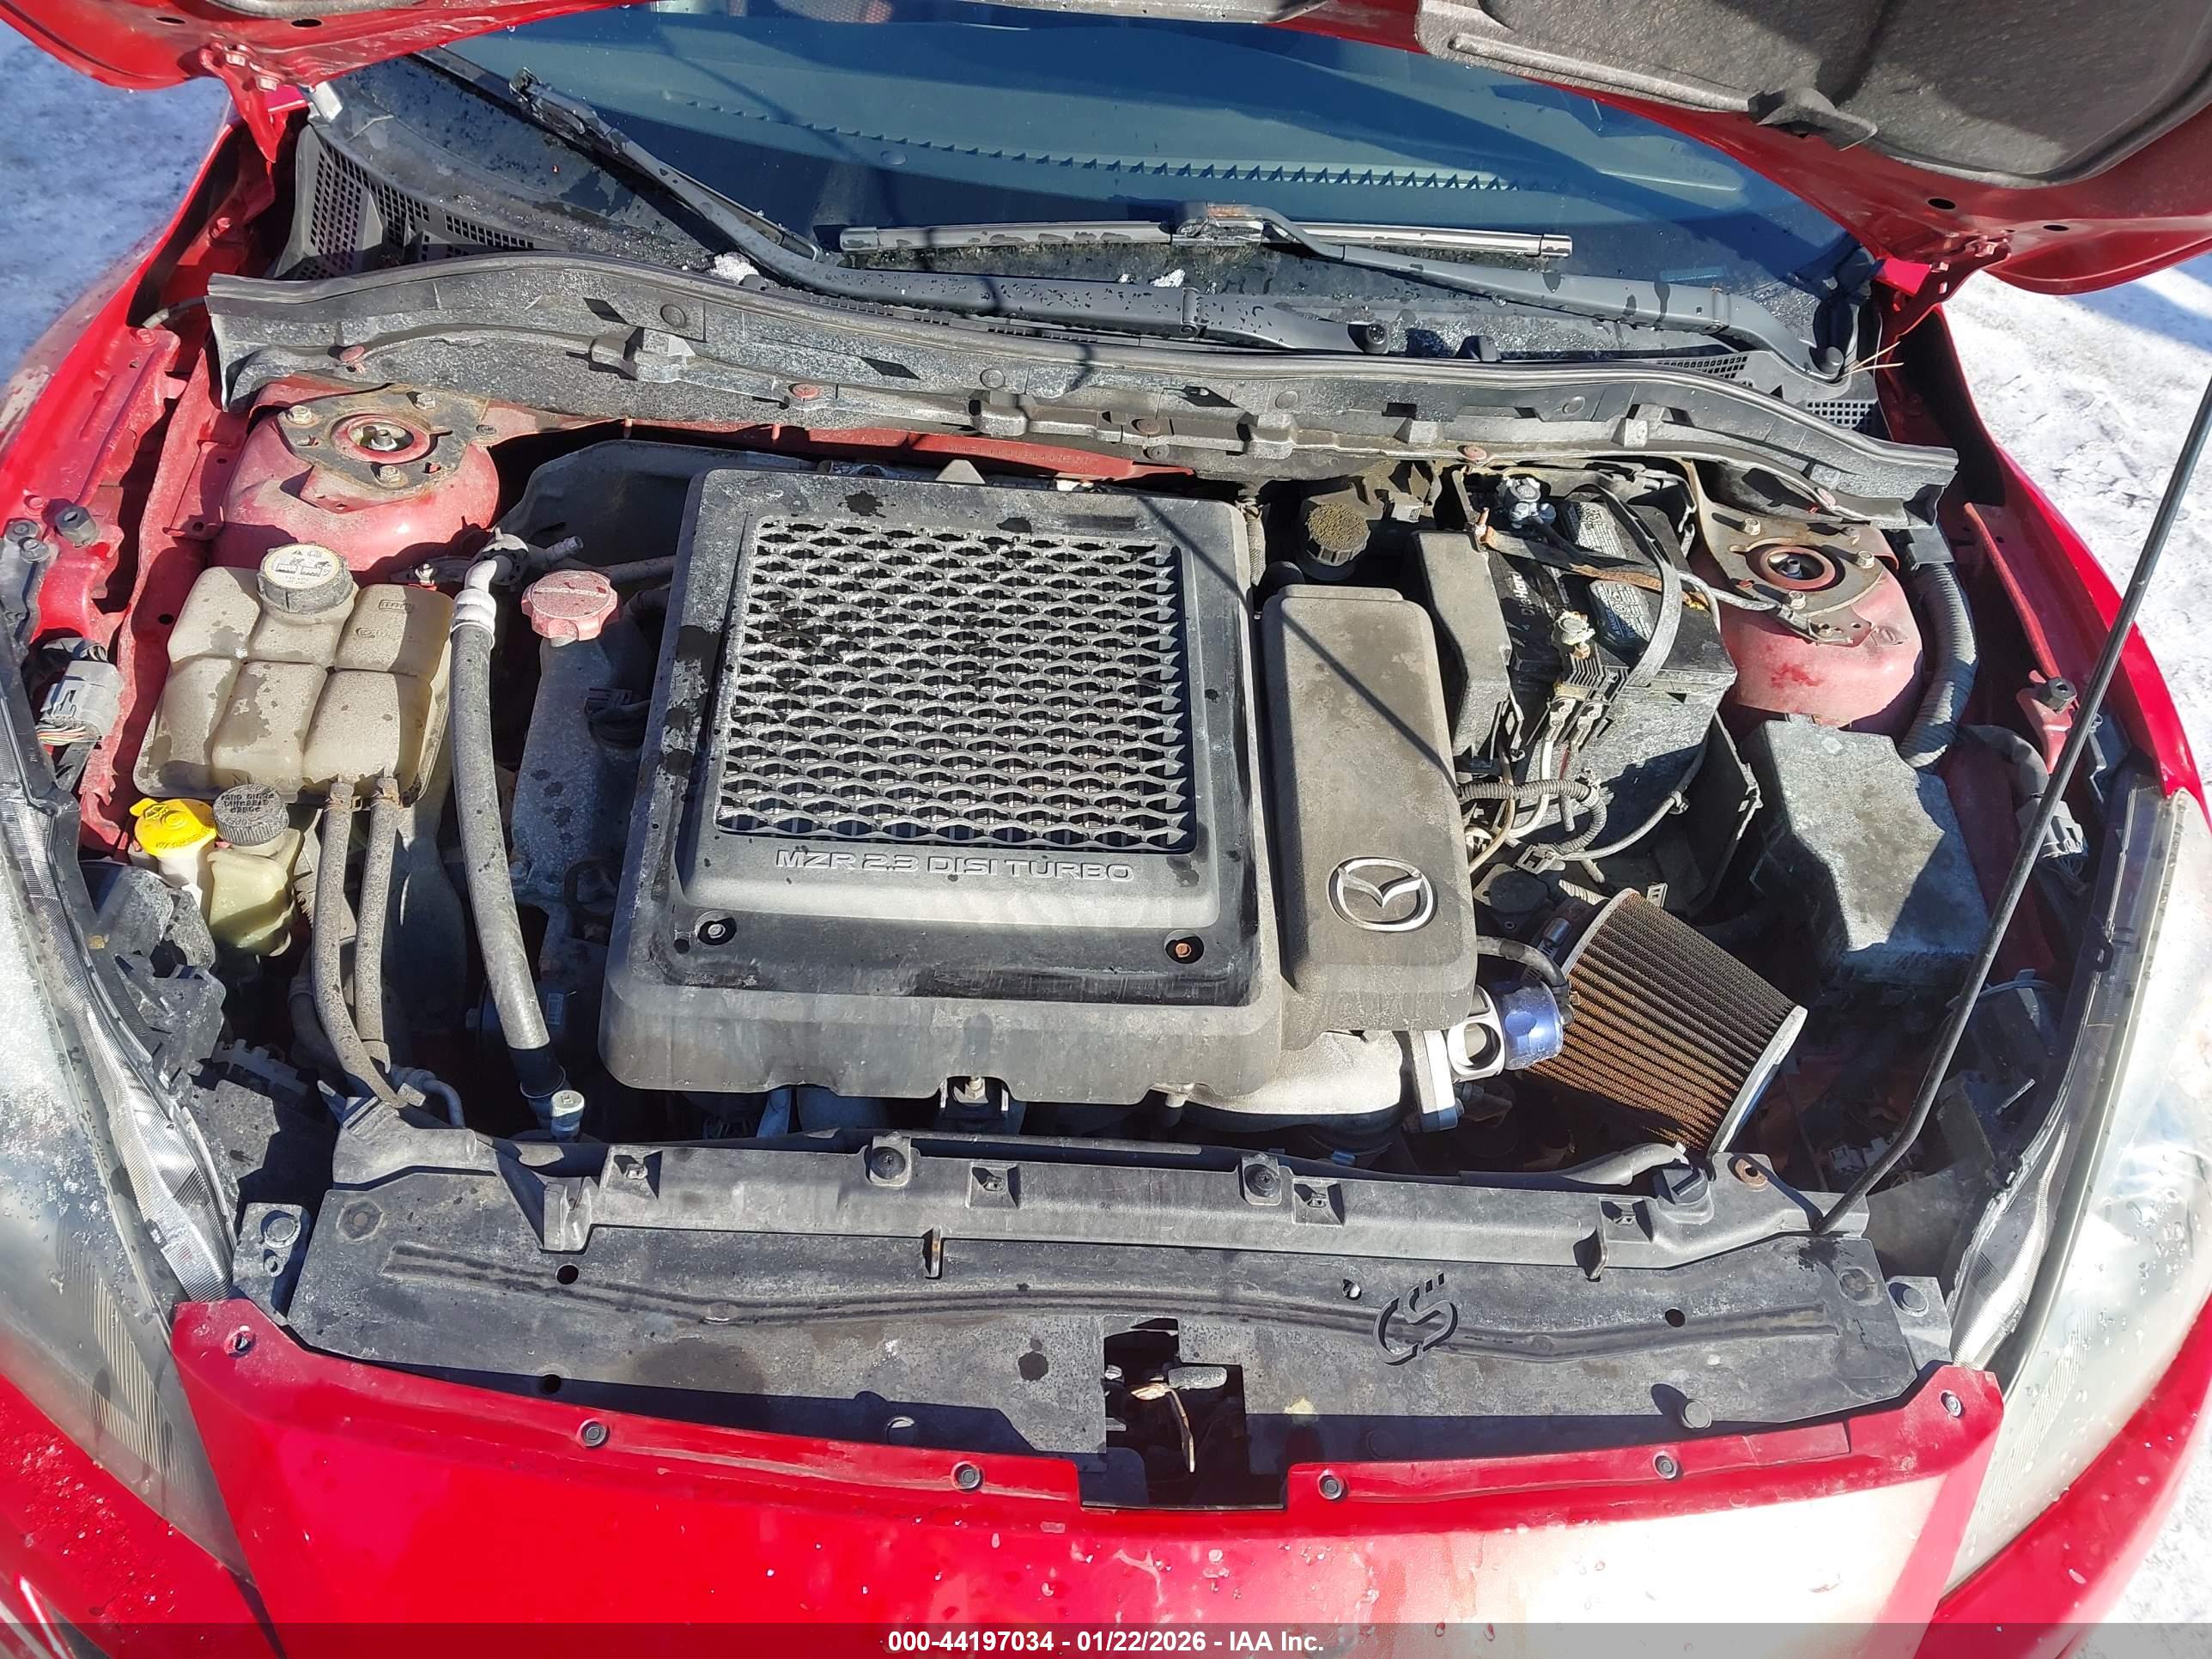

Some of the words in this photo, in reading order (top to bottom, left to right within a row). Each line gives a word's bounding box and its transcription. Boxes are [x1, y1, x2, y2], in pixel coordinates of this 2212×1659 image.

[776, 850, 856, 871] MZR
[862, 854, 920, 873] 2.3
[927, 856, 999, 877] DISI
[1005, 859, 1135, 883] TURBO
